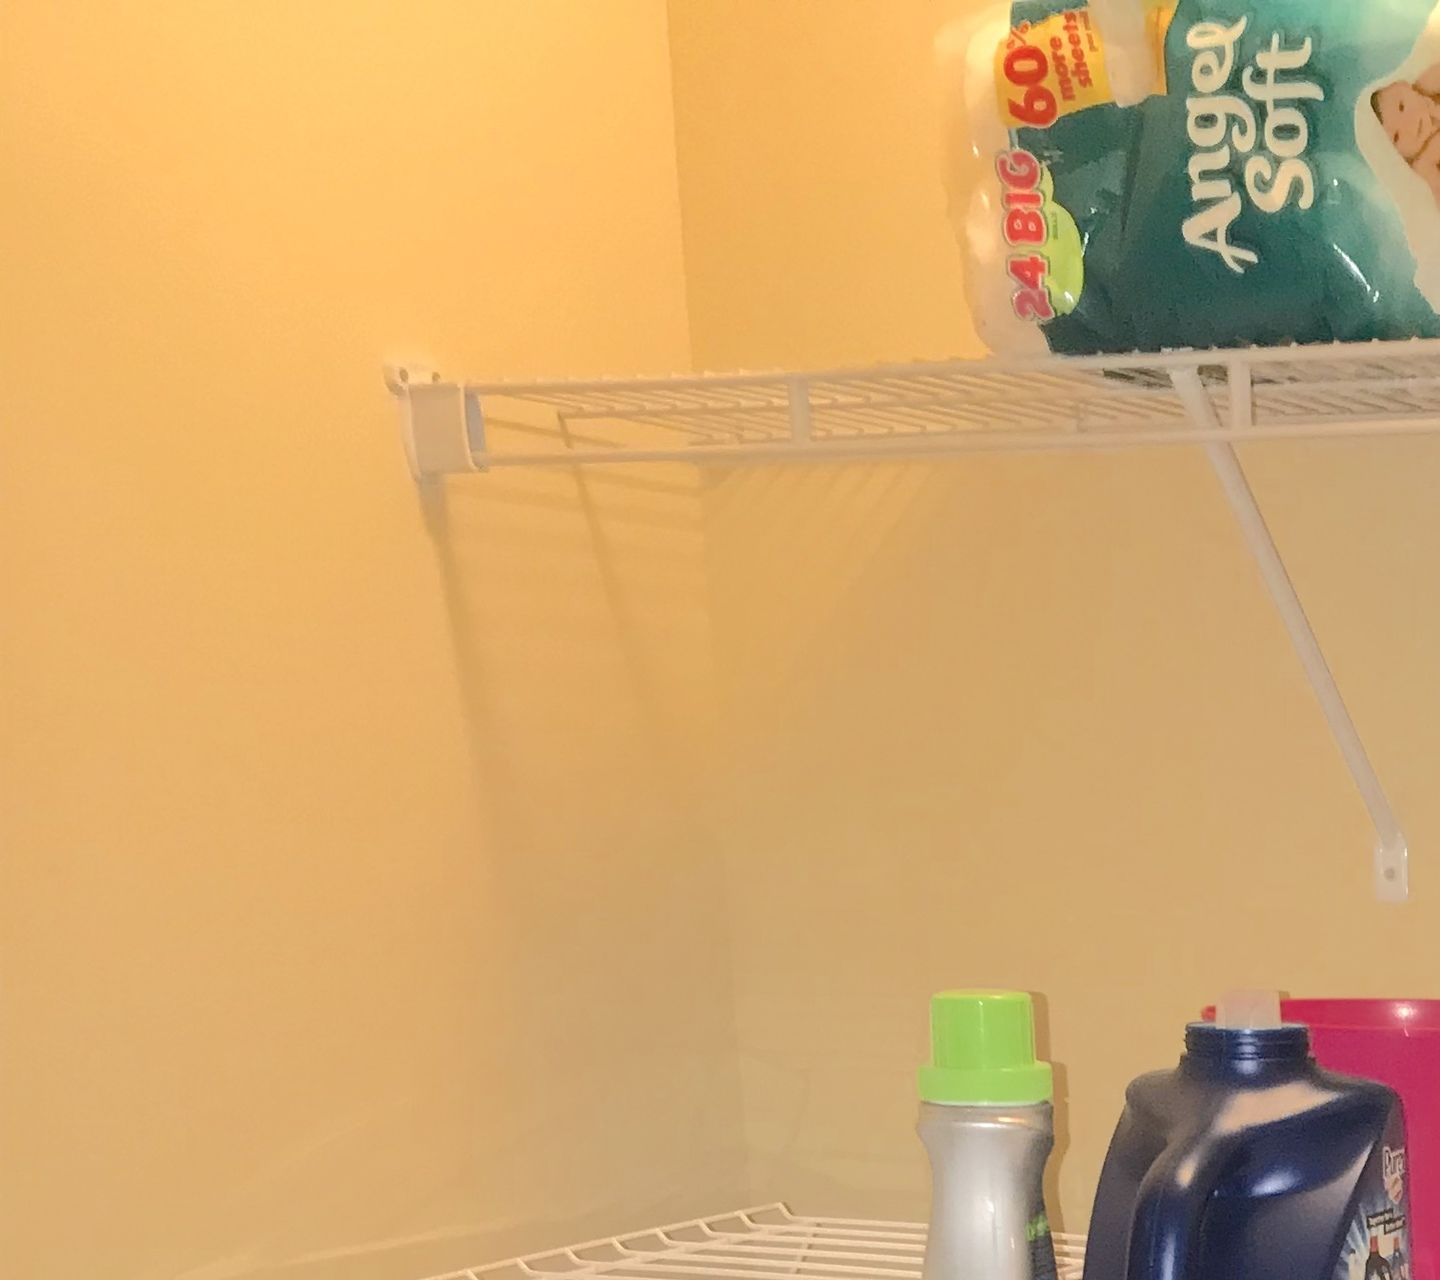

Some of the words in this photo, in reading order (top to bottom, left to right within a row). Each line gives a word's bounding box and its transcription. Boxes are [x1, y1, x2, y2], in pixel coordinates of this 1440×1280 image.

[1004, 20, 1057, 128] 60%
[1050, 36, 1076, 101] more
[1064, 11, 1093, 88] sheets
[1181, 15, 1259, 274] Angel
[1242, 32, 1325, 213] Soft
[996, 150, 1048, 246] BIG
[1009, 254, 1056, 320] 24
